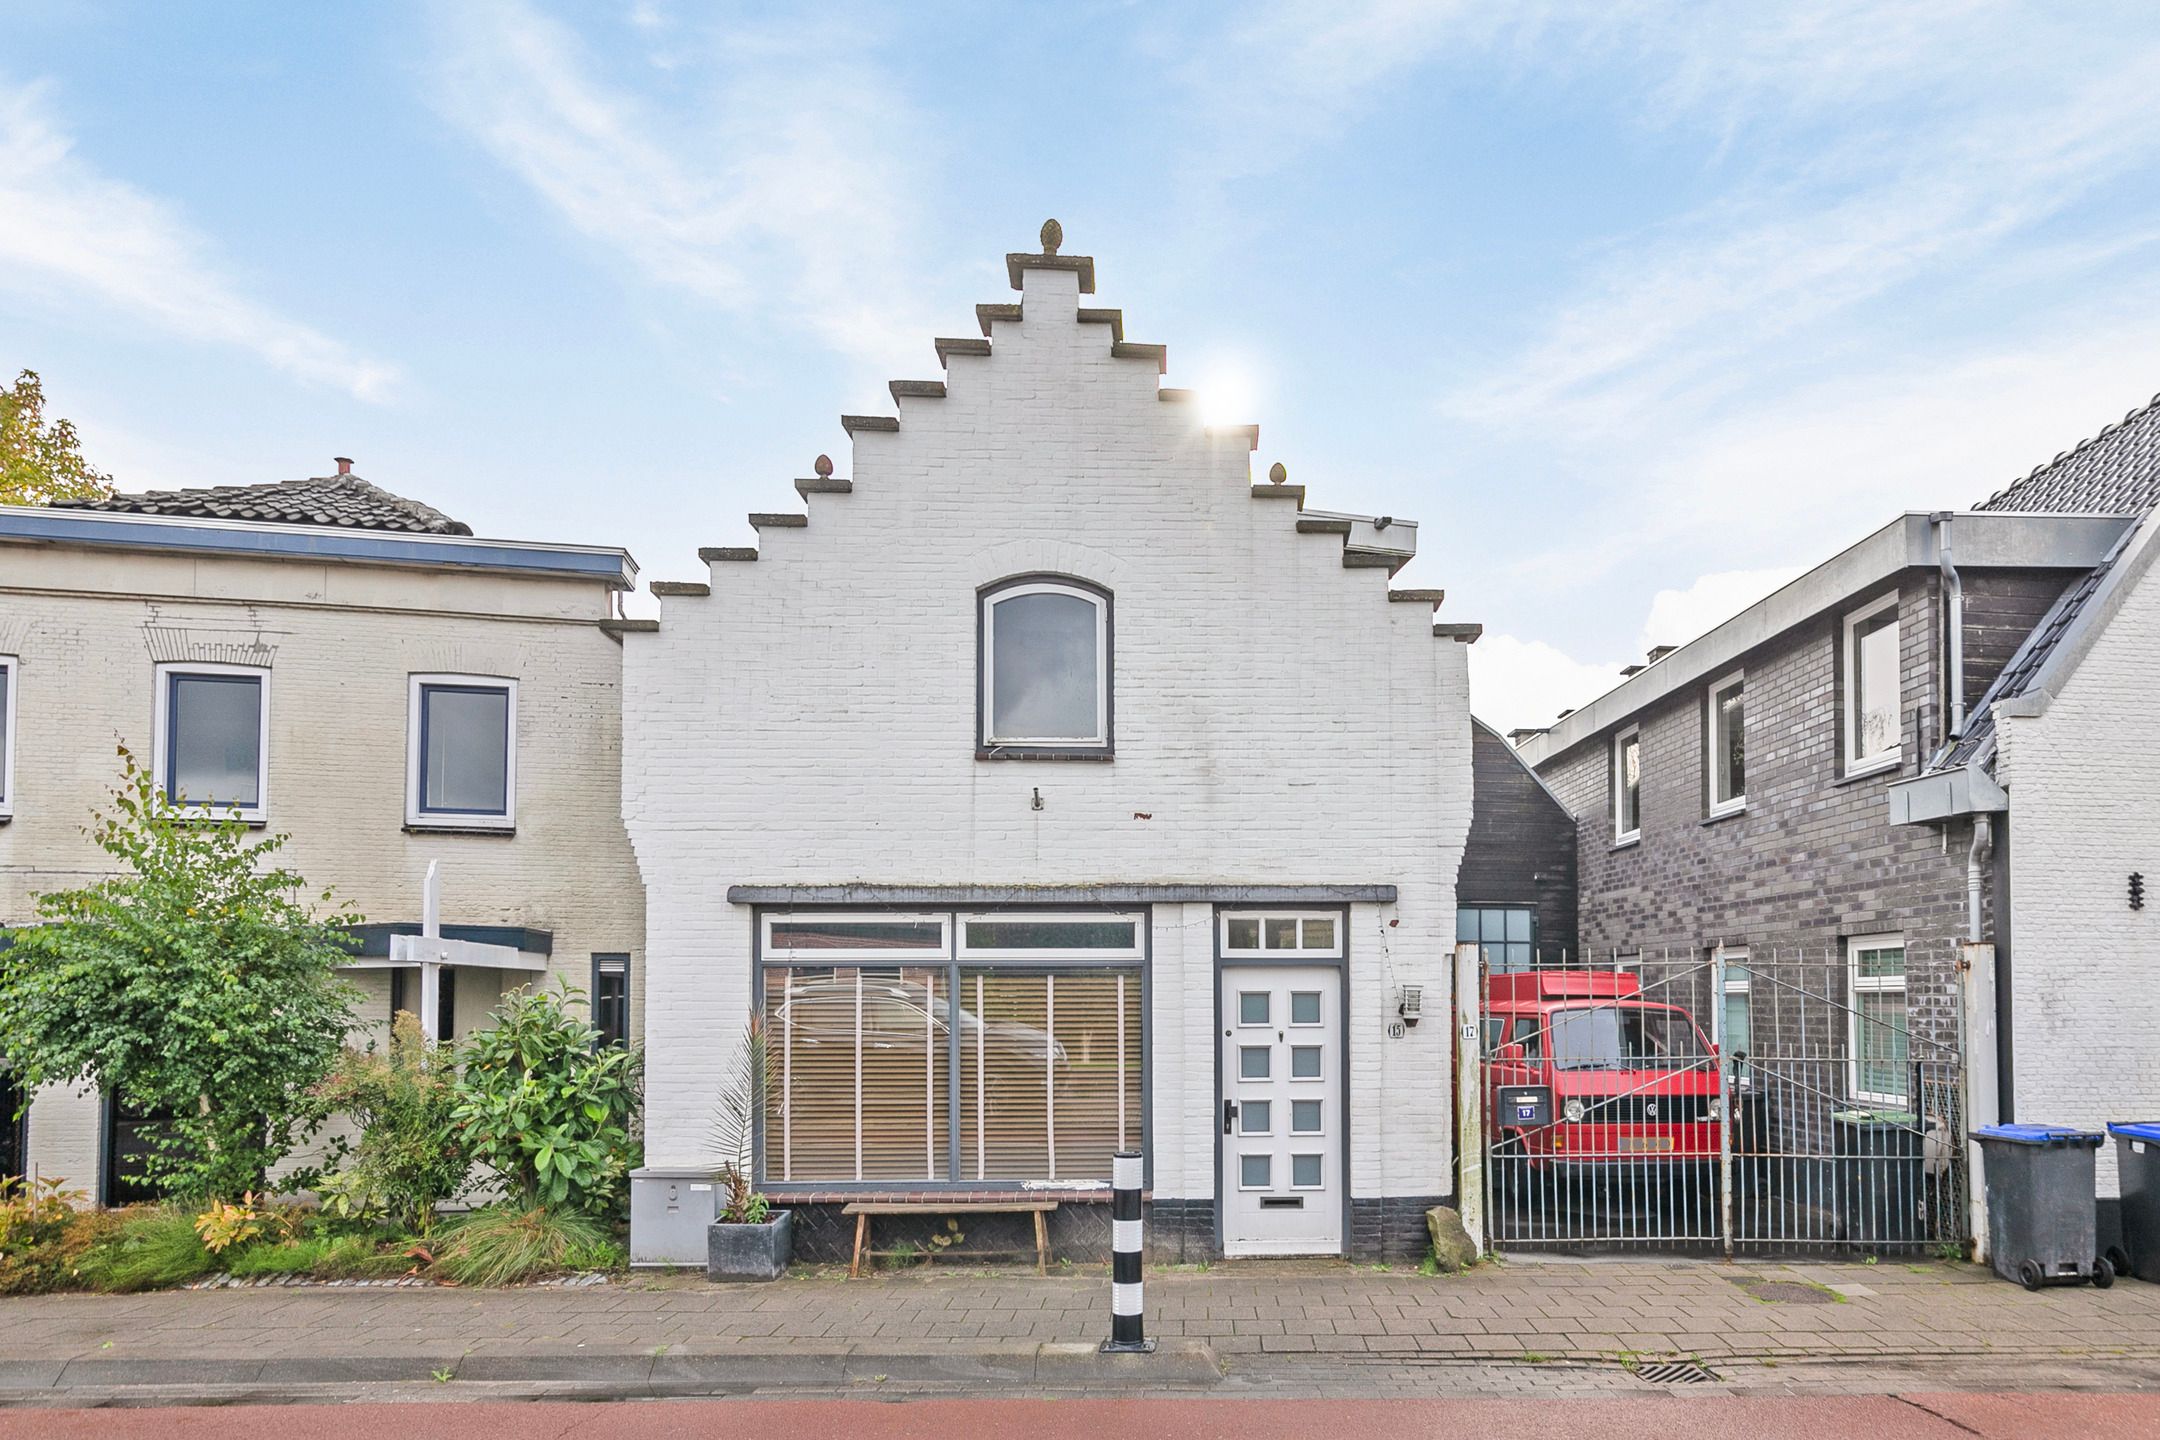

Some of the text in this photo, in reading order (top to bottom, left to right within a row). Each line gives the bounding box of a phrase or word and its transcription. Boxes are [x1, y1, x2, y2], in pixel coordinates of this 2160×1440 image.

[1391, 1023, 1401, 1037] 15
[1465, 1025, 1474, 1037] 17
[1522, 1109, 1531, 1117] 17
